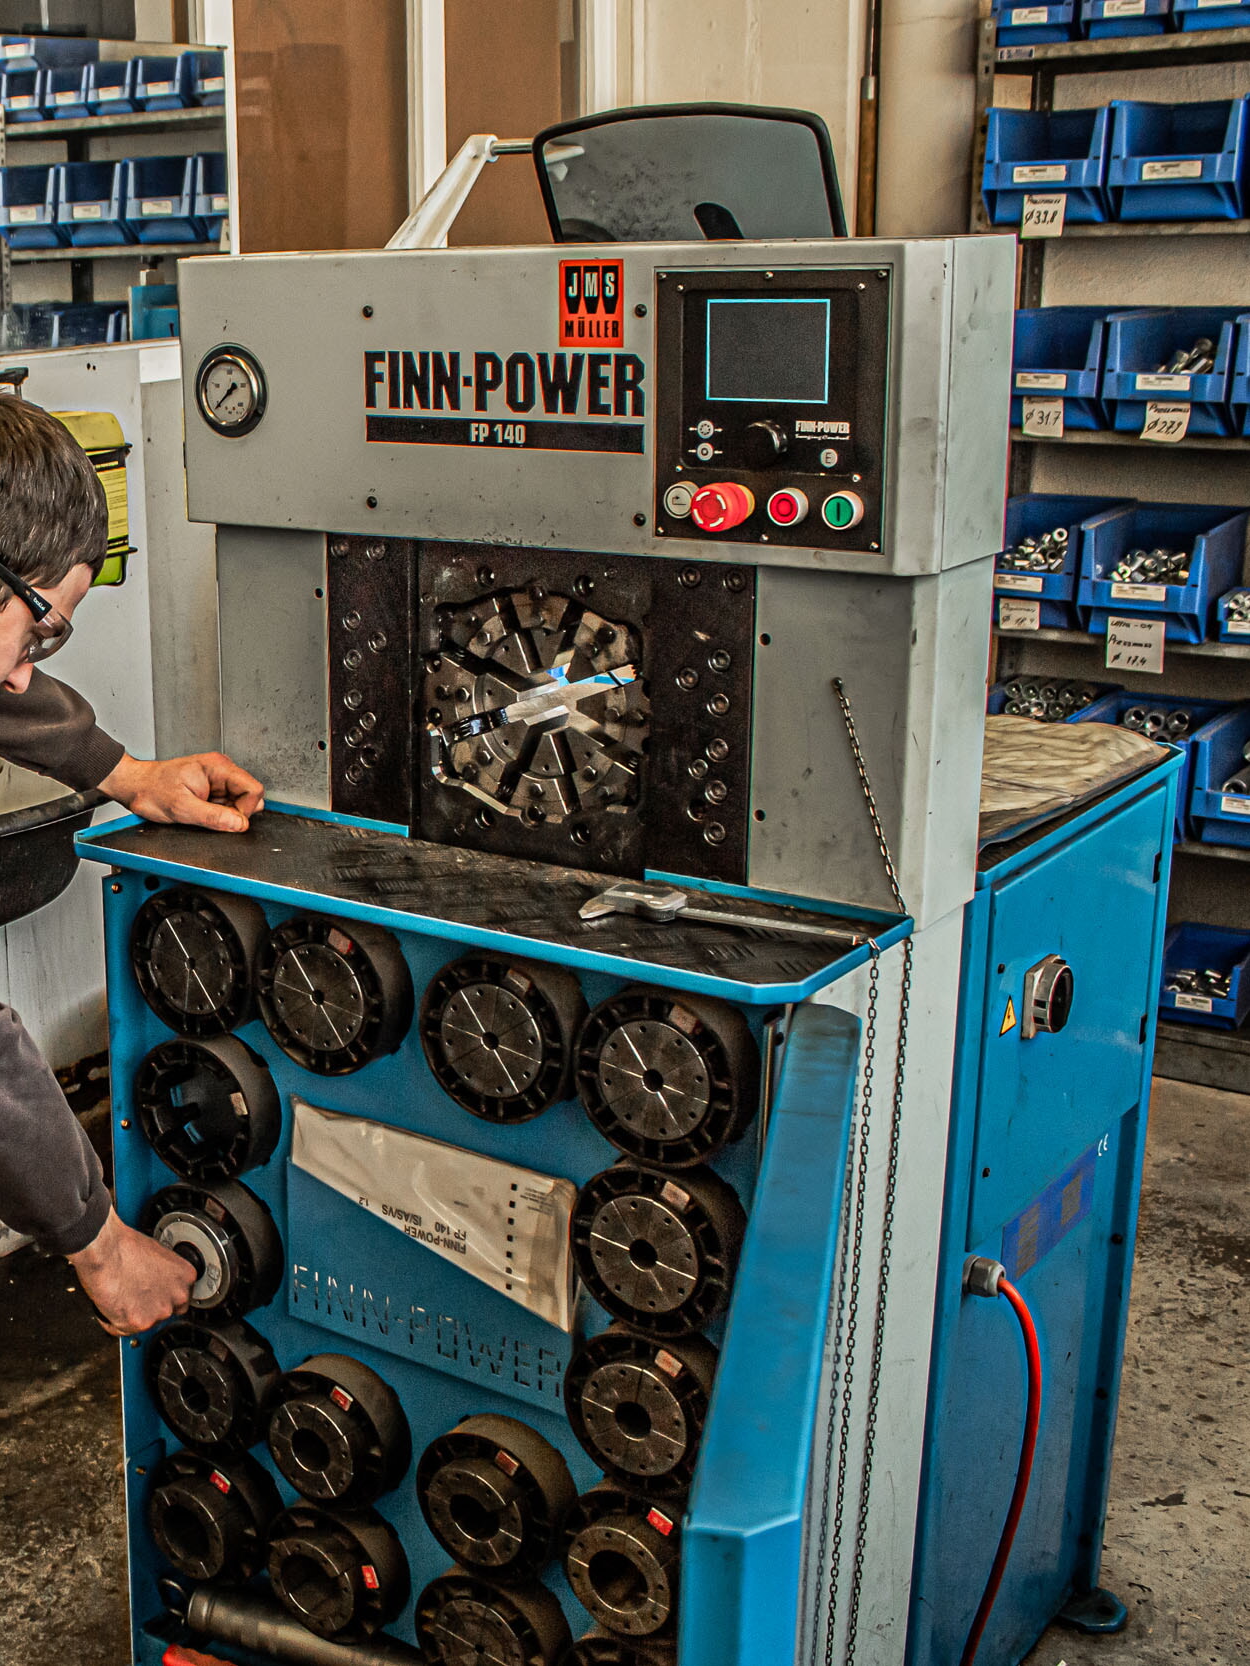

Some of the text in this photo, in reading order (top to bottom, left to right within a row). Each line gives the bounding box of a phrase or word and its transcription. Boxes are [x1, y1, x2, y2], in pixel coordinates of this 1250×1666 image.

[568, 272, 616, 298] JMS
[564, 316, 620, 338] MÜLLER
[364, 351, 646, 417] FINN-POWER
[470, 422, 526, 445] FP 140
[795, 420, 850, 434] FINN-POWER
[825, 452, 833, 465] E
[434, 1221, 451, 1235] 140
[453, 1229, 467, 1241] FP
[404, 1225, 467, 1255] FINN-POWER
[293, 1264, 561, 1398] FINN-POWER
